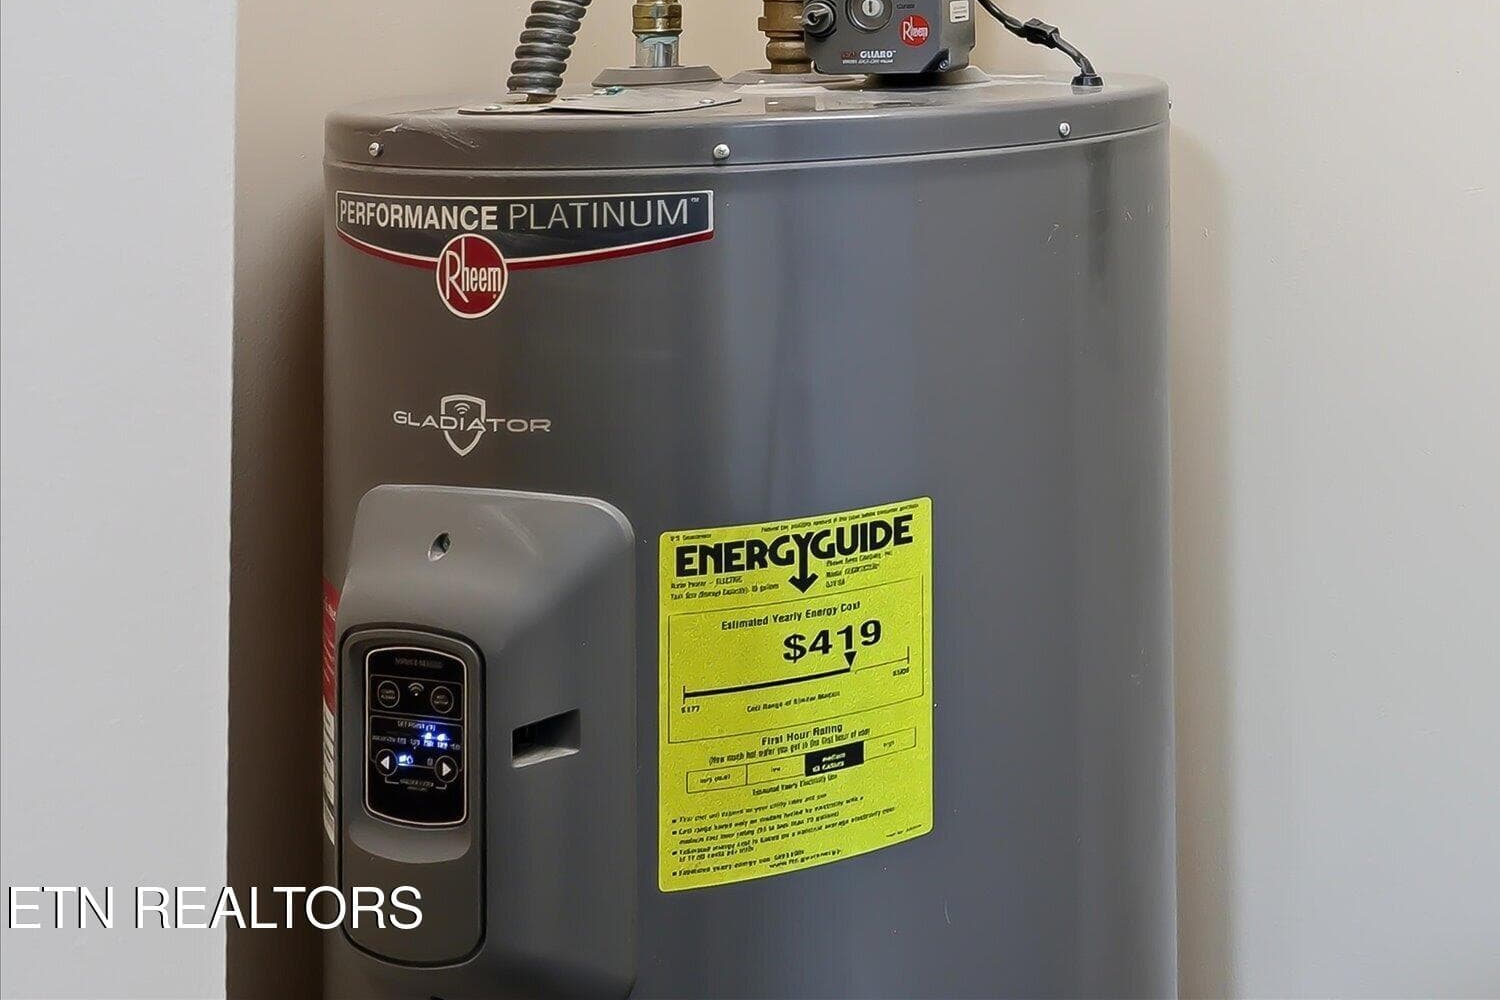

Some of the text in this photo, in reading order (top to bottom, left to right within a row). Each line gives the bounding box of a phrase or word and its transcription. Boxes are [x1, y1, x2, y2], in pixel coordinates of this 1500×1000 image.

[339, 199, 498, 231] PERFORMANCE
[444, 237, 502, 303] Rheem
[392, 411, 552, 433] GLADIATOR
[676, 514, 913, 594] ENERGYGUIDE
[721, 600, 861, 631] Estimated Yearly Energy Cost
[782, 619, 882, 664] $419
[761, 735, 783, 746] First
[786, 731, 810, 742] Hour
